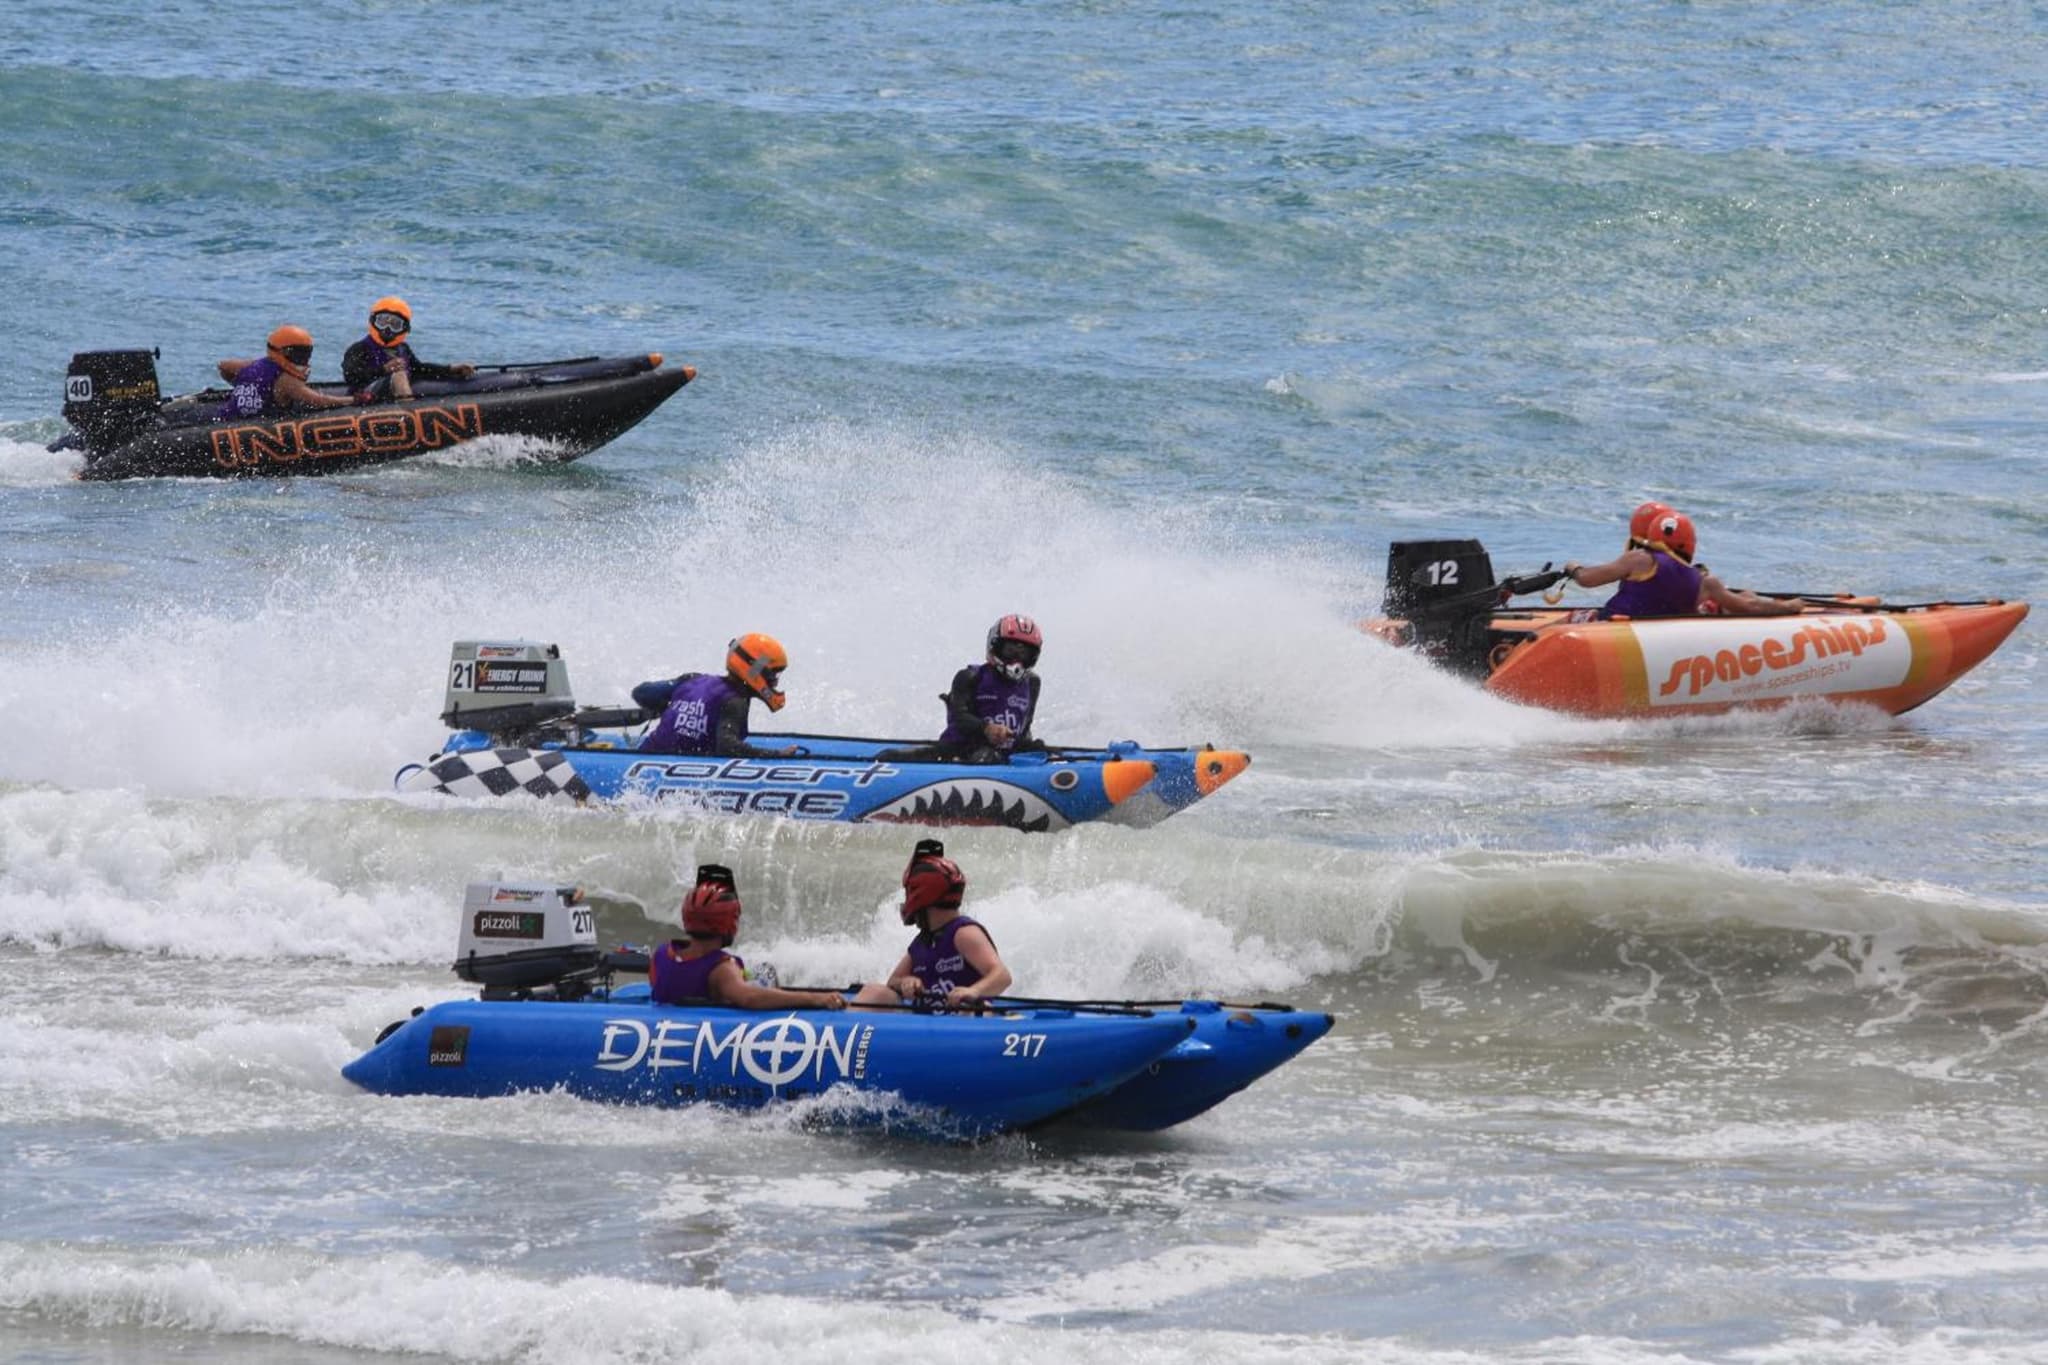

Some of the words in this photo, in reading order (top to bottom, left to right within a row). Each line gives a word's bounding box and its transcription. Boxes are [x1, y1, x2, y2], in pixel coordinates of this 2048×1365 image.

[70, 380, 90, 397] 40
[211, 403, 483, 468] INCON
[1427, 560, 1459, 585] 12
[452, 663, 473, 689] 21
[674, 713, 708, 735] pad
[625, 758, 899, 788] robert
[481, 916, 521, 932] pizzoli
[573, 911, 593, 933] 217
[593, 1011, 859, 1096] DEMON
[855, 1025, 875, 1079] ENERGY
[1002, 1033, 1048, 1058] 217
[430, 1052, 461, 1065] pizzoli
